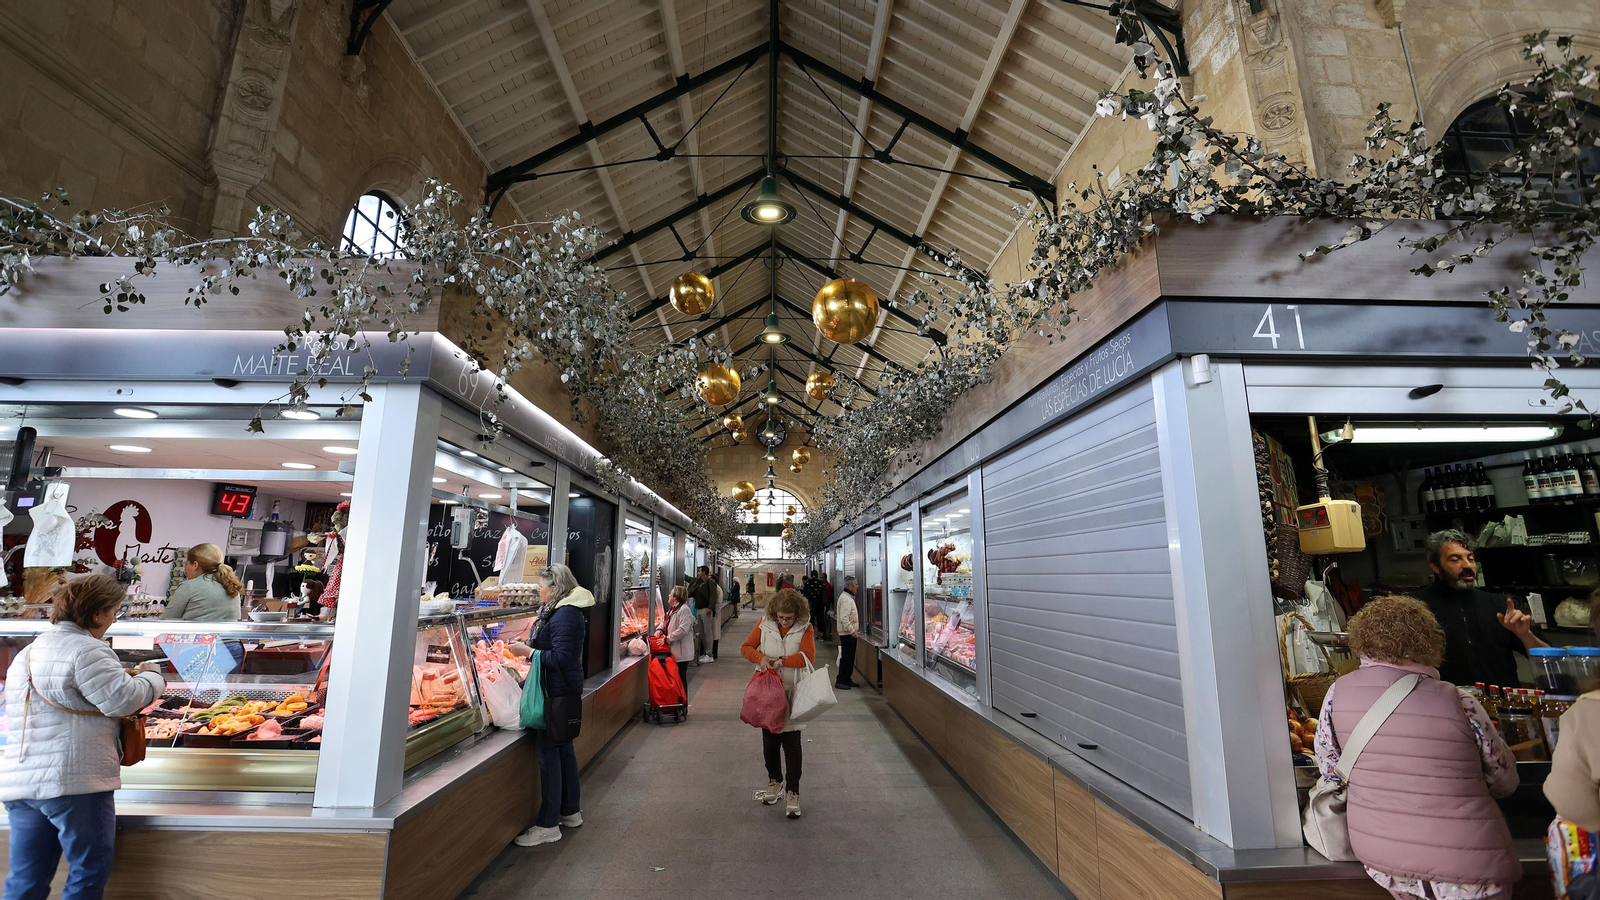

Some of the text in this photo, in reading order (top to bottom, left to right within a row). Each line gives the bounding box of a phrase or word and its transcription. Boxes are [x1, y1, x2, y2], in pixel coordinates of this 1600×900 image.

[1252, 304, 1305, 349] 41
[232, 354, 354, 376] MAITE REAL
[1060, 365, 1084, 388] Especias
[1085, 362, 1089, 375] y
[1089, 347, 1109, 368] Frutos
[458, 362, 479, 401] 69
[1041, 400, 1054, 420] LAS
[1054, 378, 1088, 413] ESPECIAS
[1089, 369, 1102, 394] DE
[221, 493, 252, 514] 43
[427, 524, 451, 537] ollo
[474, 527, 502, 539] Caz
[122, 542, 177, 564] Maite
[451, 582, 476, 600] Gal
